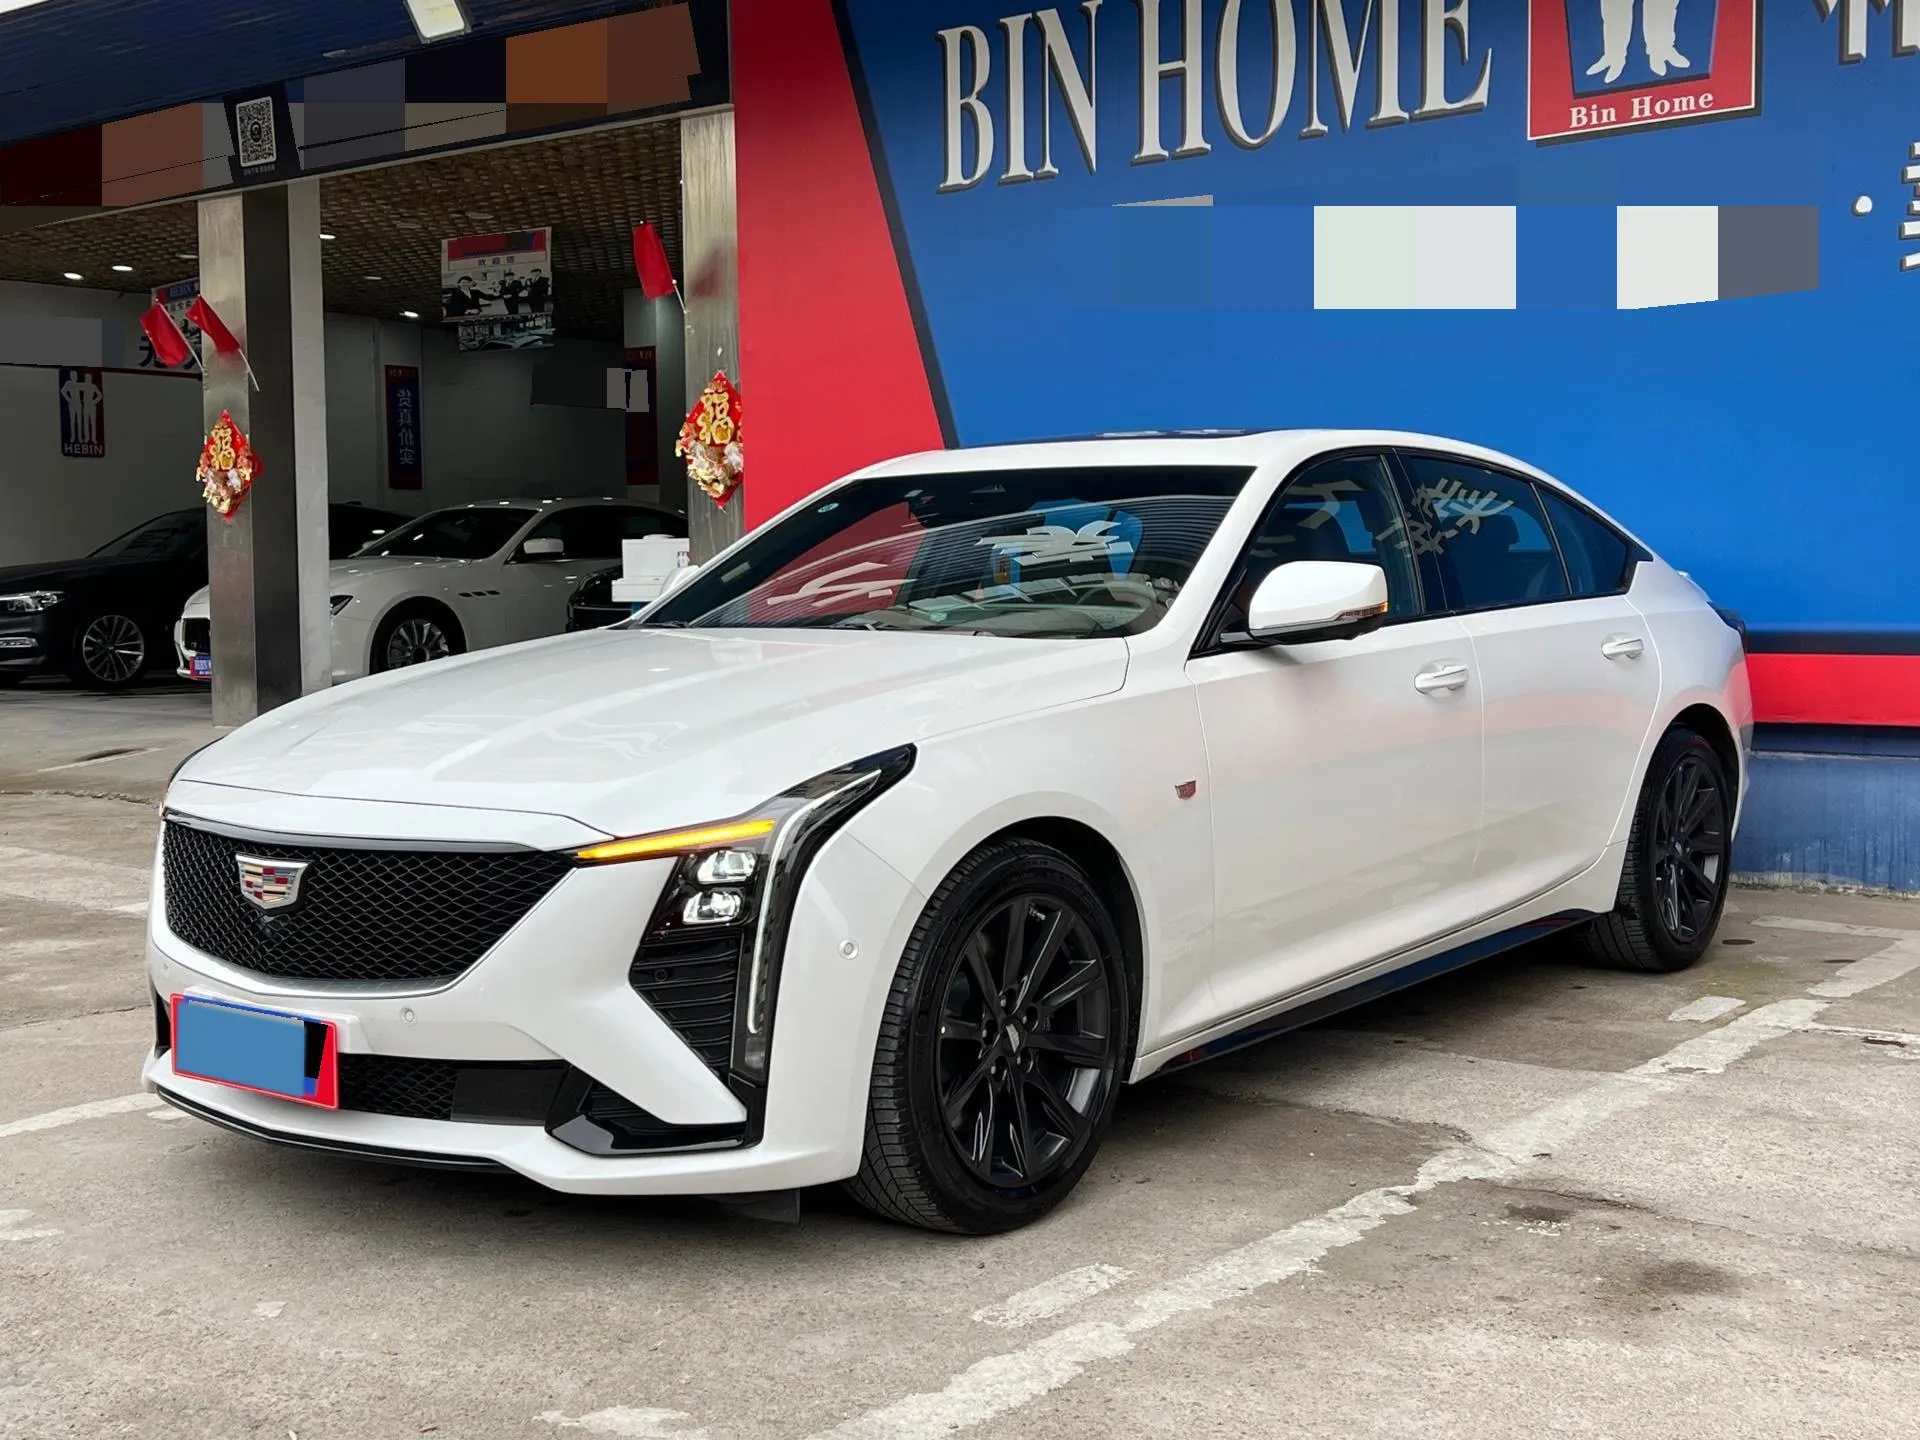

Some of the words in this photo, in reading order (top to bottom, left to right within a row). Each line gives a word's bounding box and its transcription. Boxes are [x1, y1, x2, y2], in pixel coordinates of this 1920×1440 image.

[937, 0, 1098, 192] BIN
[1131, 0, 1492, 165] HOME
[1569, 103, 1617, 129] Bin
[1631, 91, 1715, 120] Home
[64, 443, 103, 455] HEBIN
